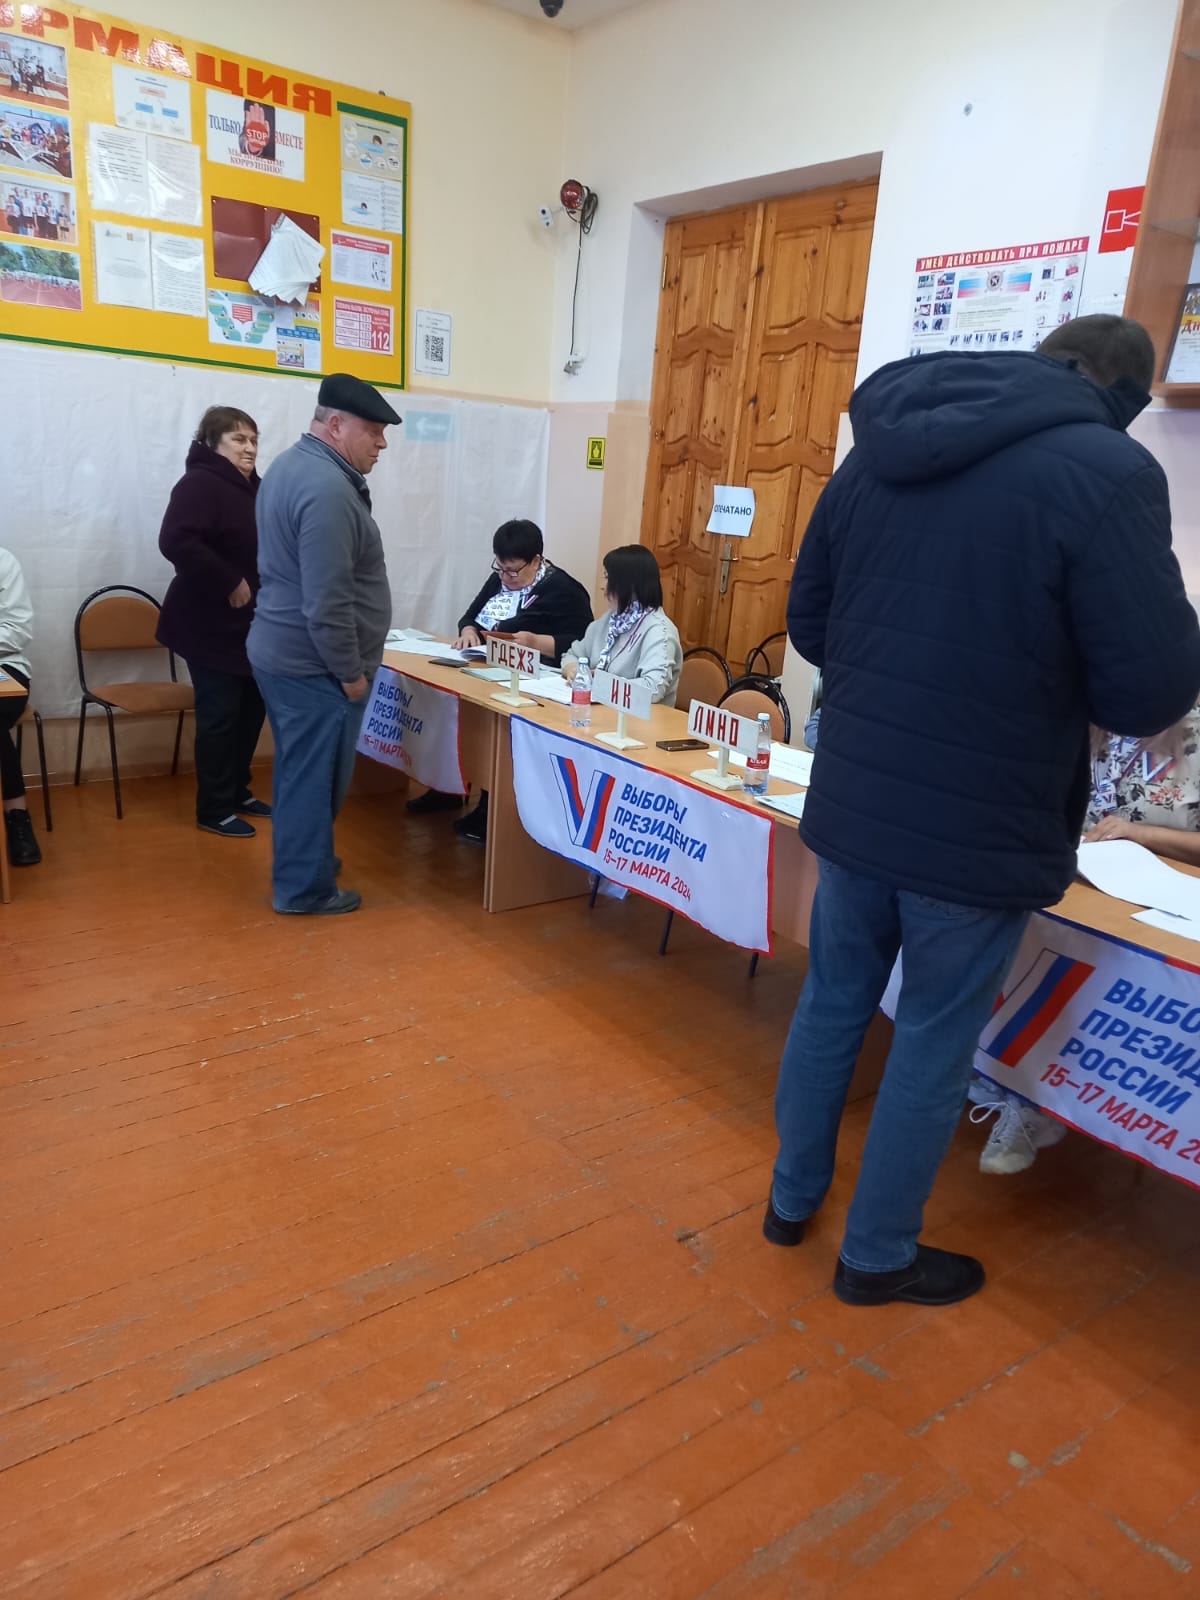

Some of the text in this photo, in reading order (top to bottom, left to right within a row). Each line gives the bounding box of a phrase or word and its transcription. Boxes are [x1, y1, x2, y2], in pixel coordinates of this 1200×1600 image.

[0, 0, 332, 117] РМАЦИЯ
[208, 114, 241, 136] ТОЛЬКО
[246, 128, 268, 140] STOP
[920, 239, 1084, 270] УМЕЙ ДЕЙСТВОВАТЬ ПРИ ПОЖАРЕ
[371, 330, 390, 350] 112
[714, 504, 752, 516] ОПЕЧАТАНО
[491, 640, 534, 674] ГДЕЖЗ
[377, 682, 413, 708] ВЫБОРЫ
[367, 717, 404, 742] РОССИИ
[372, 700, 423, 735] ПРЕЗИДЕНТА
[621, 783, 688, 824] ВЫБОРЫ
[608, 828, 671, 864] РОССИИ
[613, 806, 708, 862] ПРЕЗИДЕНТА
[630, 861, 671, 886] МАРТА
[671, 876, 692, 901] 2024
[1059, 1036, 1192, 1115] РОССИИ
[1097, 1095, 1179, 1150] МАРТА
